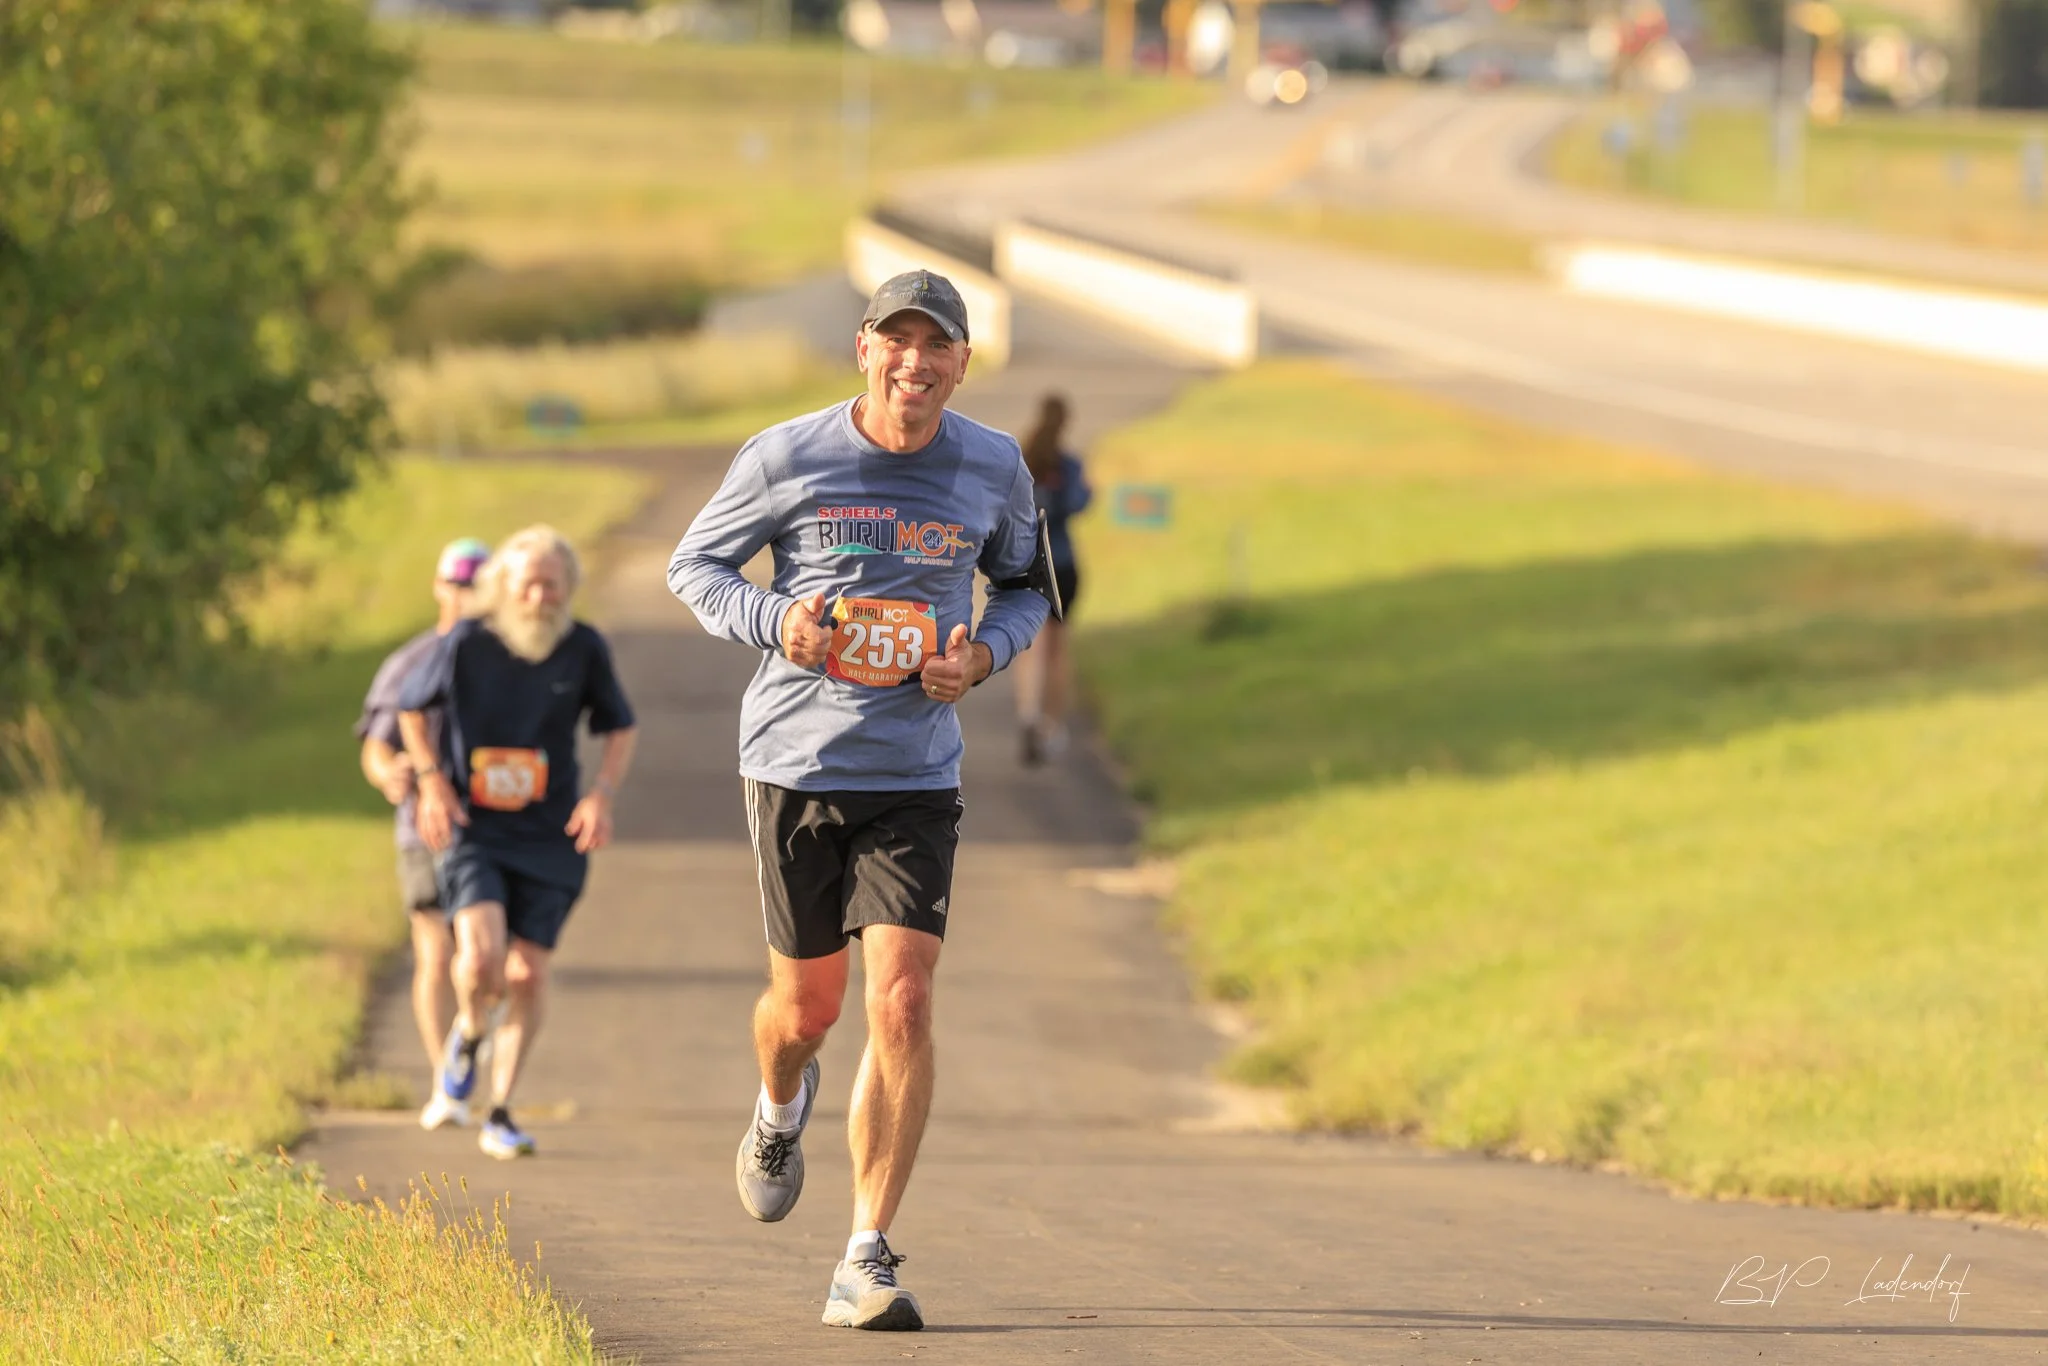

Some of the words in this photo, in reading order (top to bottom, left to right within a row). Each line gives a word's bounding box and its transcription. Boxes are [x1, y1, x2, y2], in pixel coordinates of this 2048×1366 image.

[818, 507, 896, 518] SCHEELS
[924, 533, 943, 547] 24
[840, 623, 924, 670] 253
[848, 669, 866, 679] HALF
[869, 671, 908, 681] MARATHON
